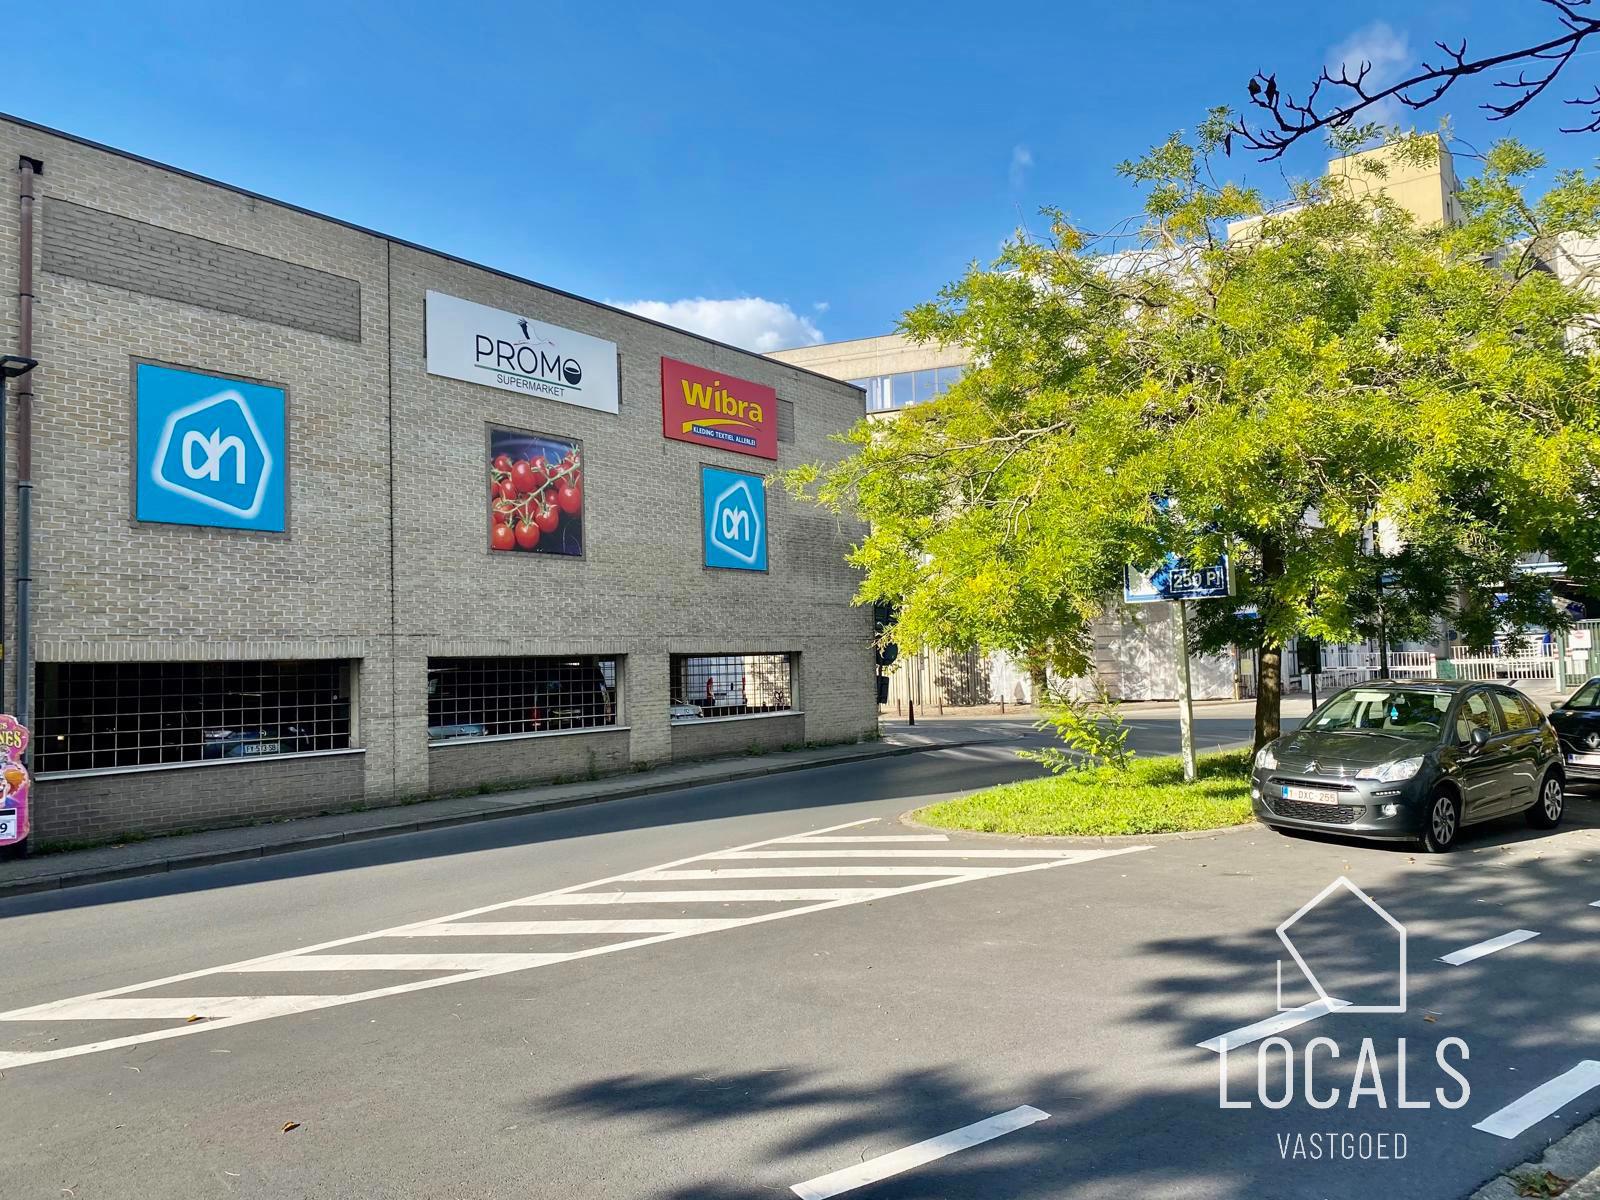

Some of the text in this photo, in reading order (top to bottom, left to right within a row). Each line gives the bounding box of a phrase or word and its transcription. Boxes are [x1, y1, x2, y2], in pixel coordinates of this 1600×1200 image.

[476, 334, 582, 385] PROMO
[496, 373, 565, 397] SUPERMARKET
[681, 379, 763, 423] Wibra
[693, 426, 756, 446] KLEDING TEXTIEL ALLERLEI
[1173, 570, 1202, 588] 250
